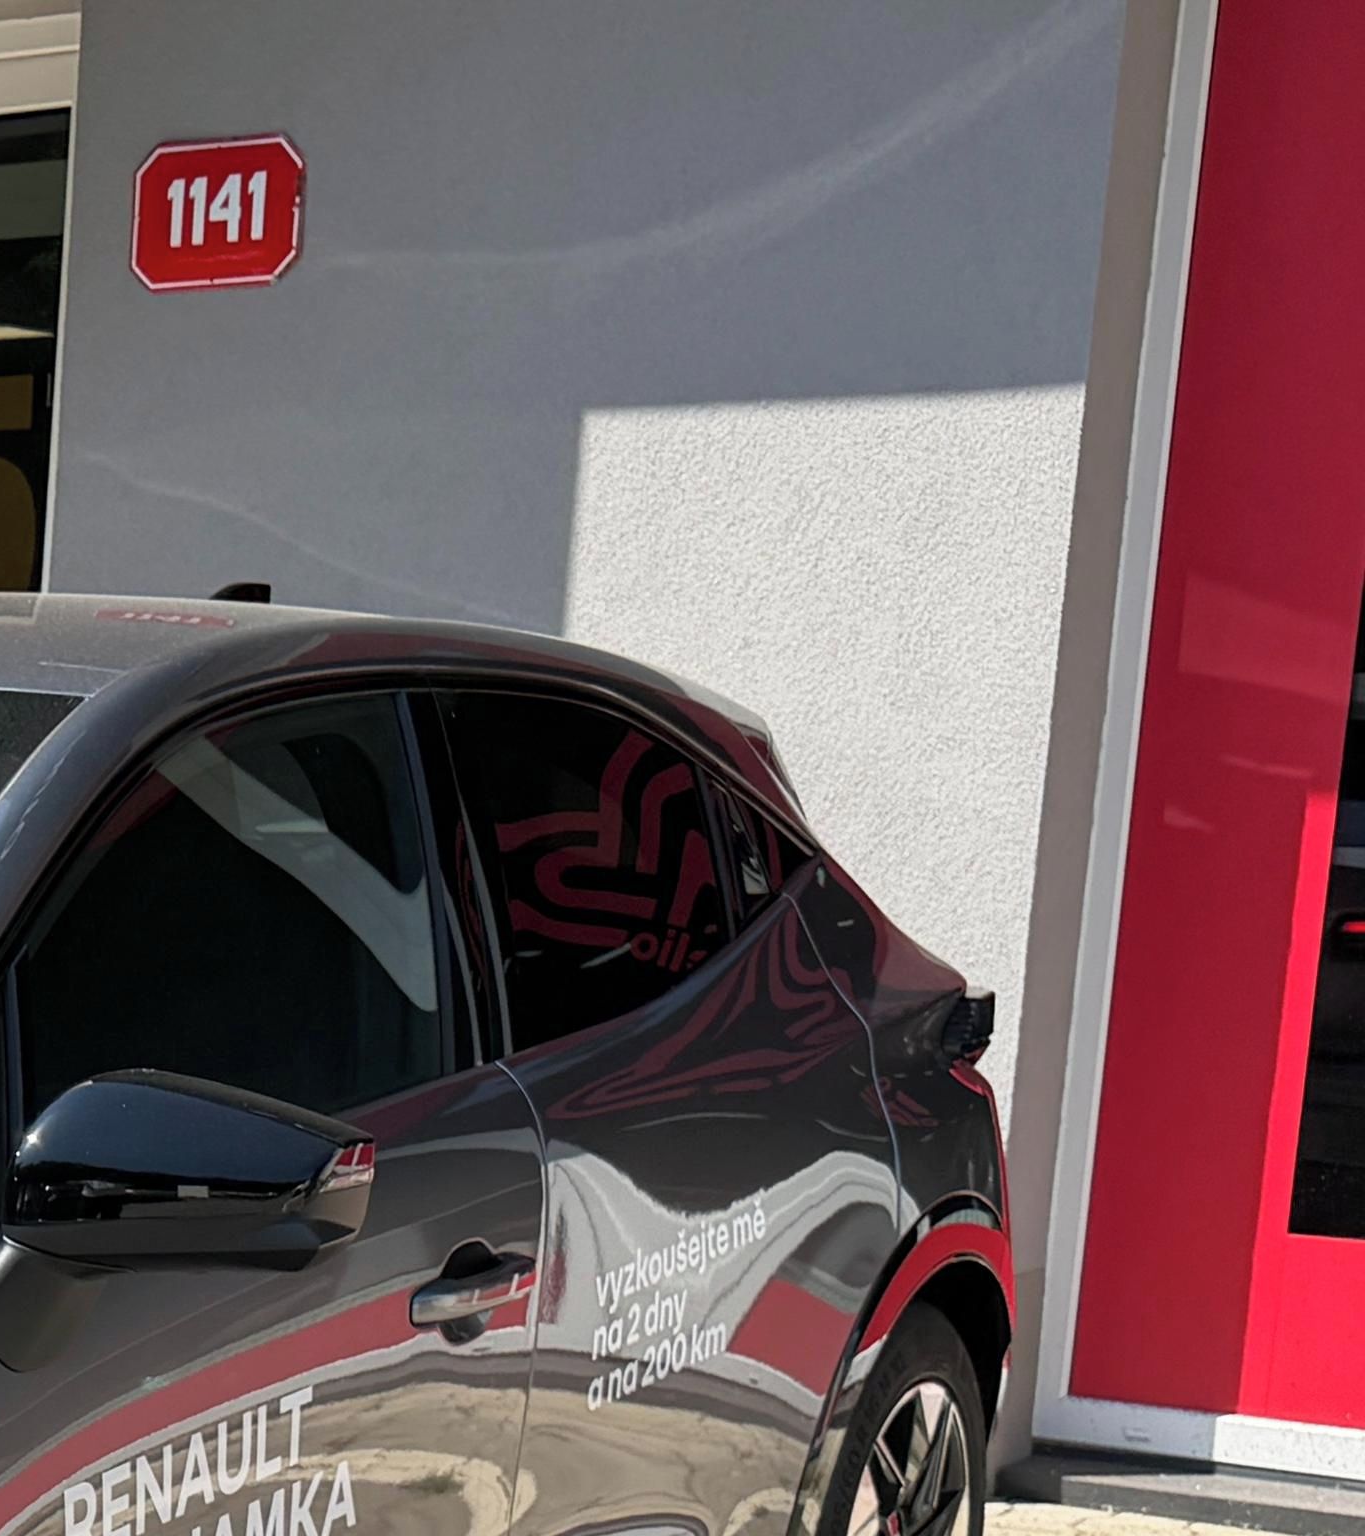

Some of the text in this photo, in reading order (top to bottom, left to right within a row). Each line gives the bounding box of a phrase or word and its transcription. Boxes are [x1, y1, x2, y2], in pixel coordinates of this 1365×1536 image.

[167, 170, 267, 248] 1141
[595, 1198, 767, 1314] vyzkoušejte mě
[587, 1321, 727, 1411] a na 200 km
[591, 1289, 688, 1361] na 2 dny
